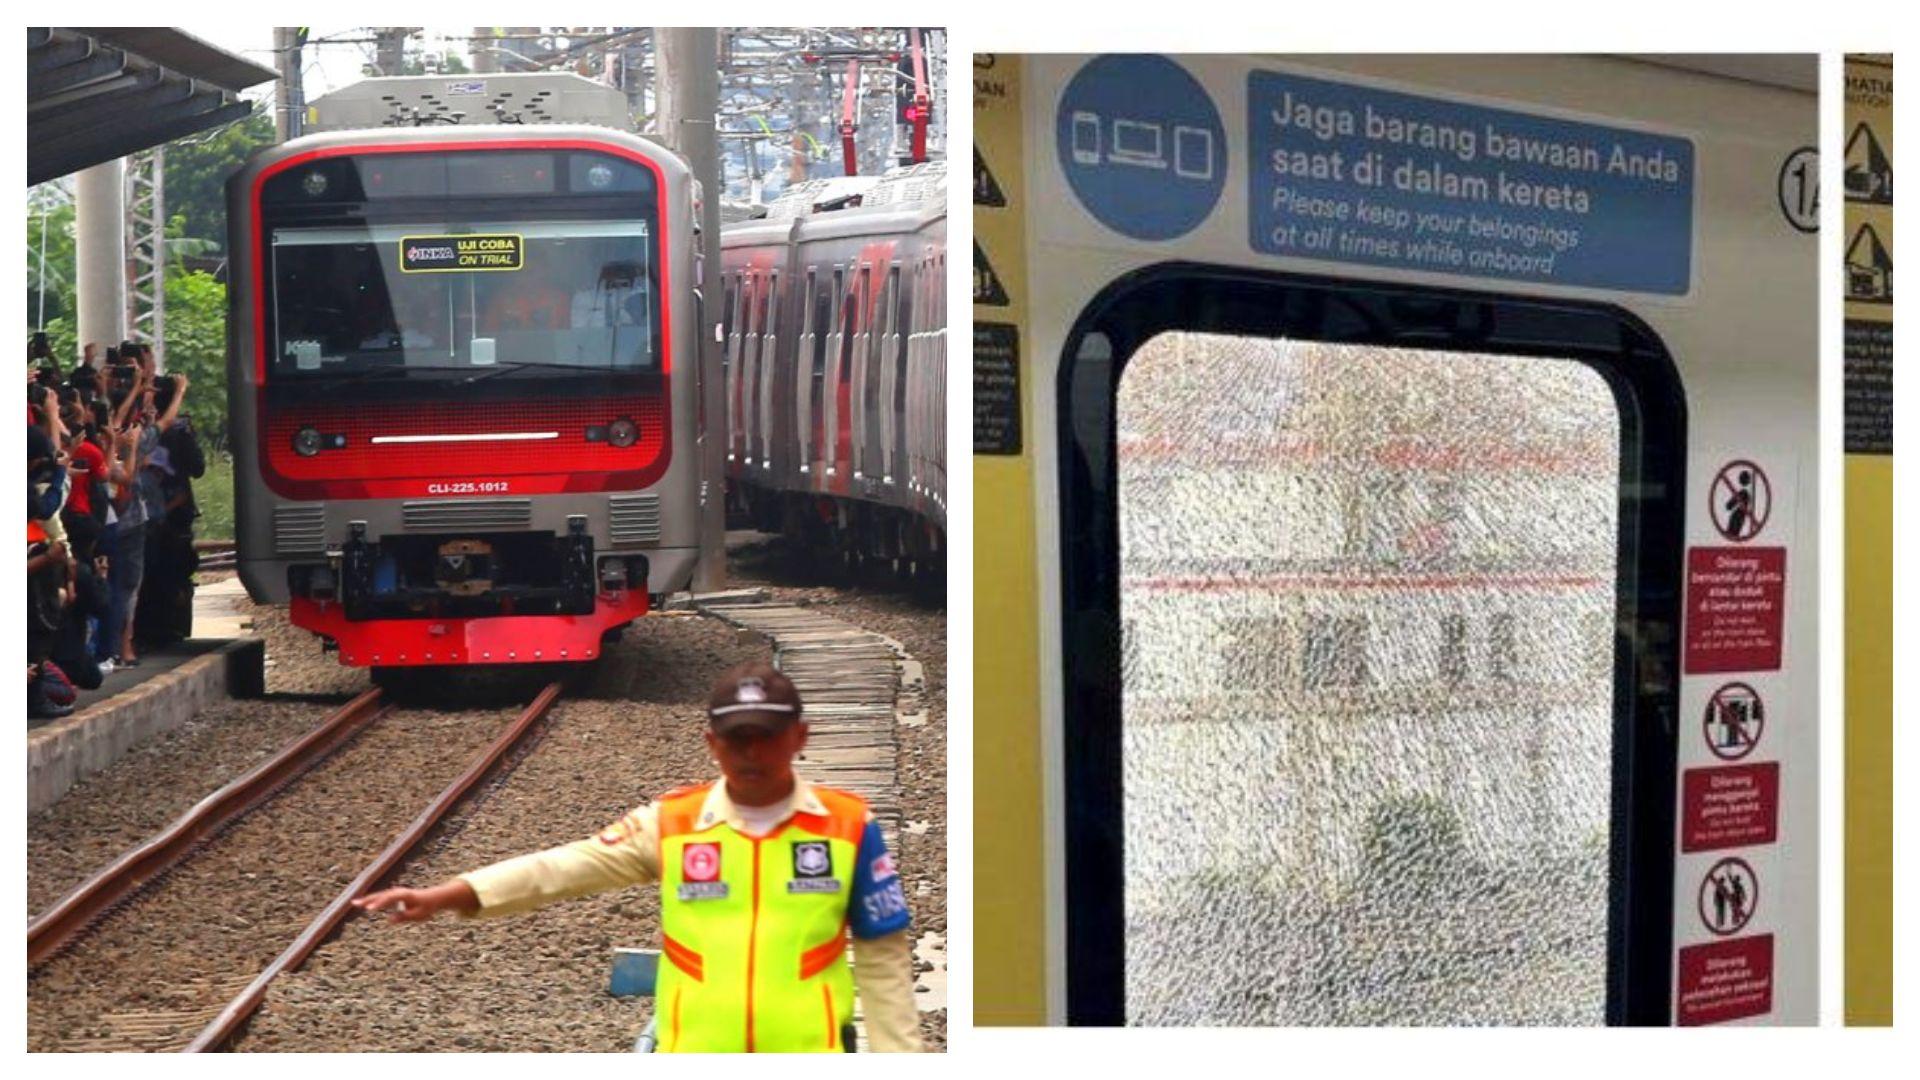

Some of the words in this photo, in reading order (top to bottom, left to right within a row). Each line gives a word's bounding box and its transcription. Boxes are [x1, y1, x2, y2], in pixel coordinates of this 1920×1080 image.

[1272, 92, 1354, 140] Jaga
[1365, 105, 1476, 161] barang
[1486, 124, 1600, 171] bawaan
[1606, 144, 1678, 182] Anda
[1272, 150, 1344, 181] saat
[1354, 152, 1383, 187] di
[1394, 160, 1489, 200] dalam
[1498, 171, 1589, 213] kereta
[1273, 187, 1349, 221] Please
[1357, 200, 1410, 231] keep
[1417, 211, 1465, 233] your
[1469, 213, 1579, 251] belongings
[418, 246, 455, 261] INKA
[457, 240, 476, 250] UJI
[479, 239, 515, 250] COBA
[459, 255, 478, 265] ON
[481, 253, 514, 265] TRIAL
[1272, 226, 1299, 245] at
[1304, 227, 1333, 248] all
[1340, 231, 1399, 257] times
[1406, 239, 1464, 264] while
[1468, 247, 1555, 273] onboard
[428, 481, 509, 494] CLI-225.1012
